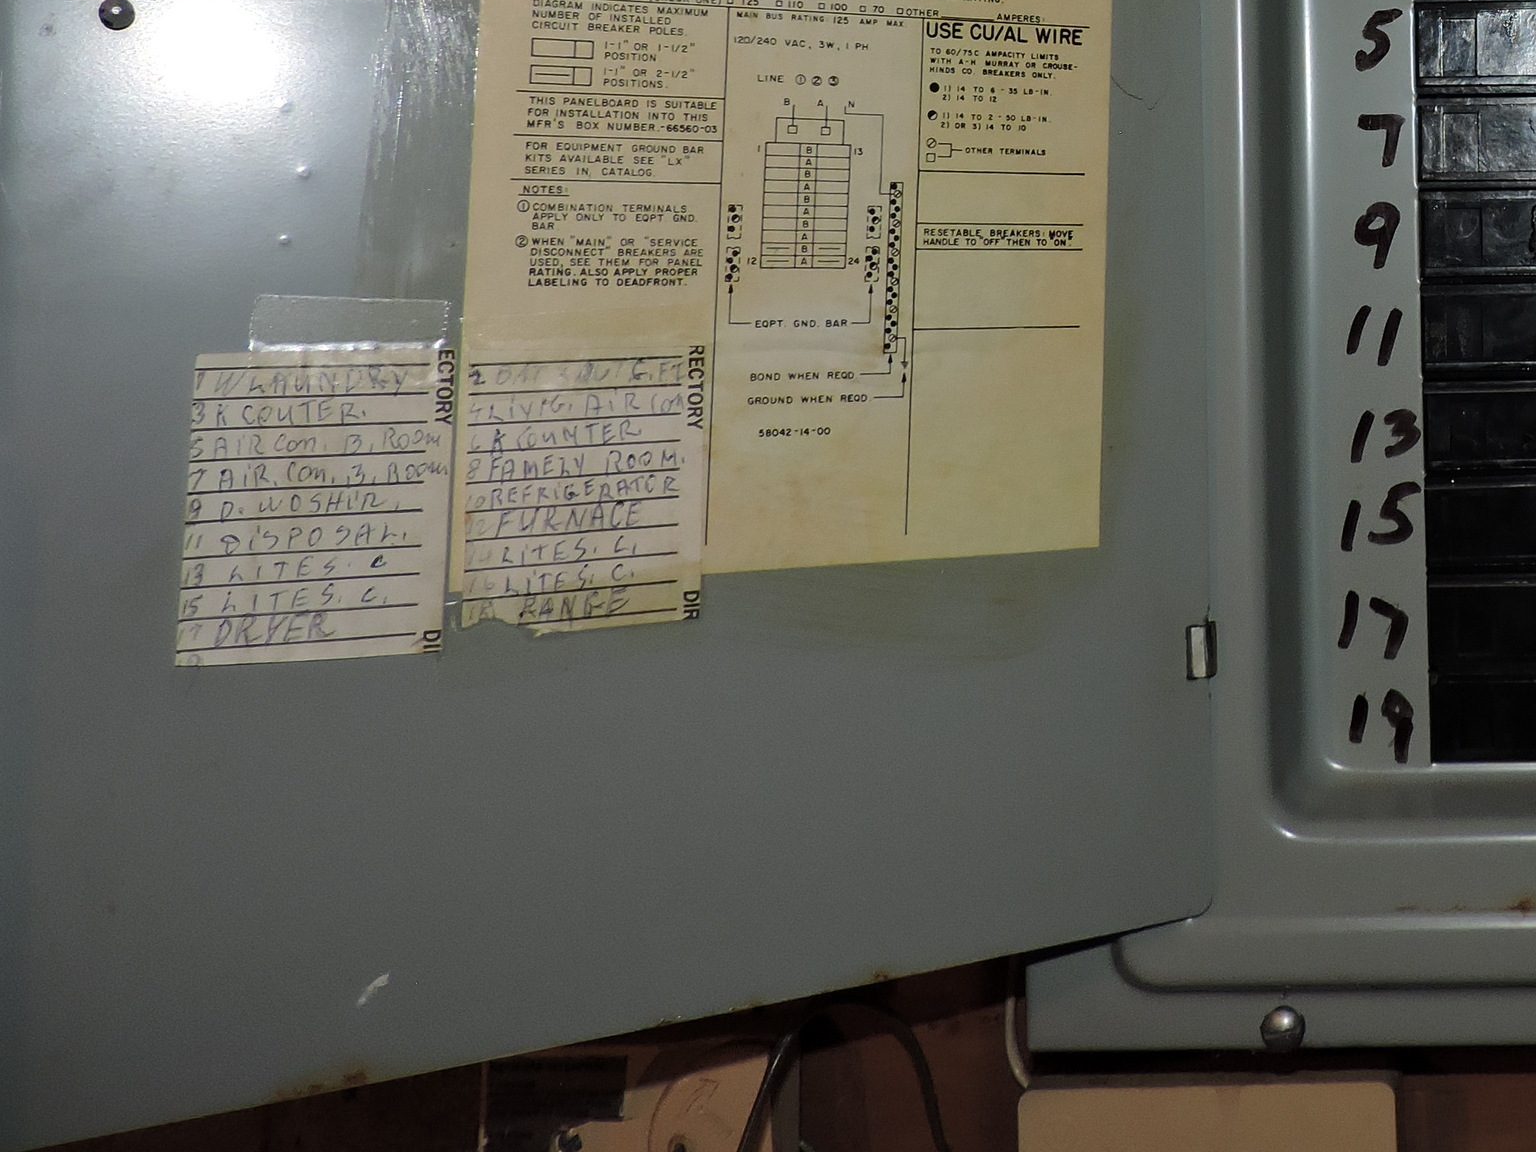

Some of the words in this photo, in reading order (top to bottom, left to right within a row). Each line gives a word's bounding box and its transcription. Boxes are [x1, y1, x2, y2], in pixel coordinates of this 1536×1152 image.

[926, 21, 964, 40] USE
[970, 23, 1029, 44] CU/AL
[1035, 27, 1084, 46] WIRE
[1355, 8, 1403, 72] 5
[757, 74, 784, 83] LINE
[527, 107, 549, 117] FOR
[555, 109, 639, 120] INSTALLATION
[648, 112, 675, 121] INTO
[683, 113, 708, 122] THIS
[529, 96, 556, 106] THIS
[563, 97, 639, 108] PANELBOARD
[646, 99, 657, 108] IS
[664, 100, 717, 110] SUITABLE
[576, 120, 599, 130] BOX
[999, 148, 1046, 156] TERMINALS
[1358, 114, 1405, 167] 7
[1354, 202, 1400, 269] 9
[825, 319, 848, 328] BAR
[1346, 305, 1403, 366] 11
[750, 372, 781, 382] BOND
[787, 372, 819, 381] WHEN
[747, 395, 793, 405] GROUND
[800, 395, 833, 404] WHEN
[1351, 409, 1421, 463] 13
[1341, 481, 1421, 552] 15
[1338, 590, 1408, 660] 17
[1349, 688, 1414, 764] 19
